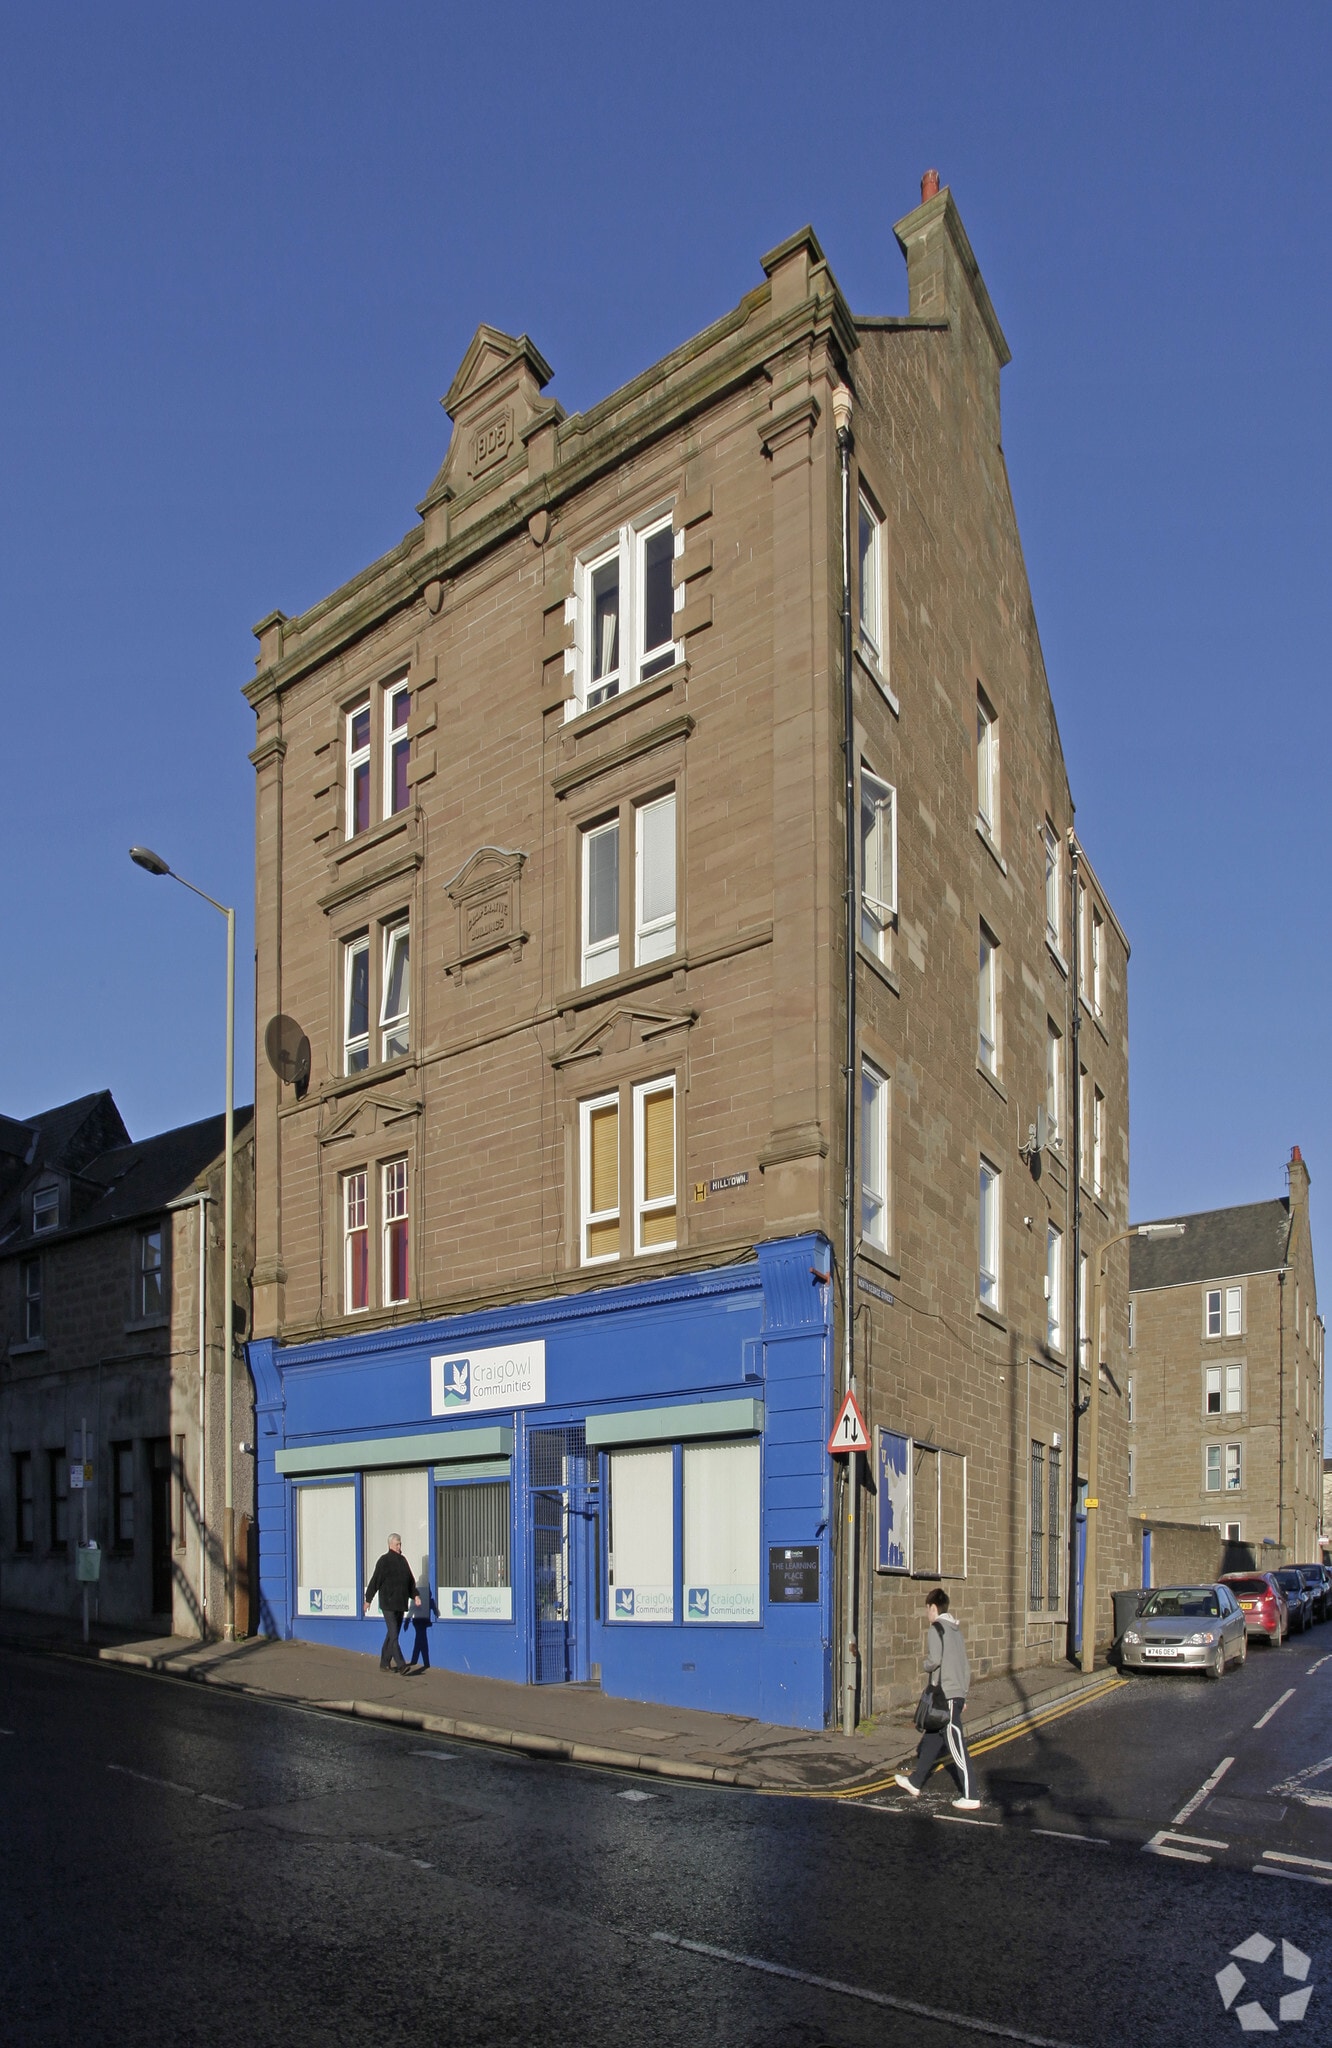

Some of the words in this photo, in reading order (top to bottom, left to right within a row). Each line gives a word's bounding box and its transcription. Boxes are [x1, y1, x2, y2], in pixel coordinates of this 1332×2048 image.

[695, 1184, 705, 1201] H
[473, 1356, 531, 1384] CraigOwl
[473, 1381, 531, 1397] Communities
[772, 1562, 784, 1570] THE
[785, 1562, 817, 1570] LEARNING
[636, 1592, 673, 1606] CraigOw
[711, 1592, 755, 1607] CraigOwl
[469, 1605, 501, 1613] Communities
[636, 1605, 673, 1614] Communitie
[710, 1606, 755, 1615] Communities
